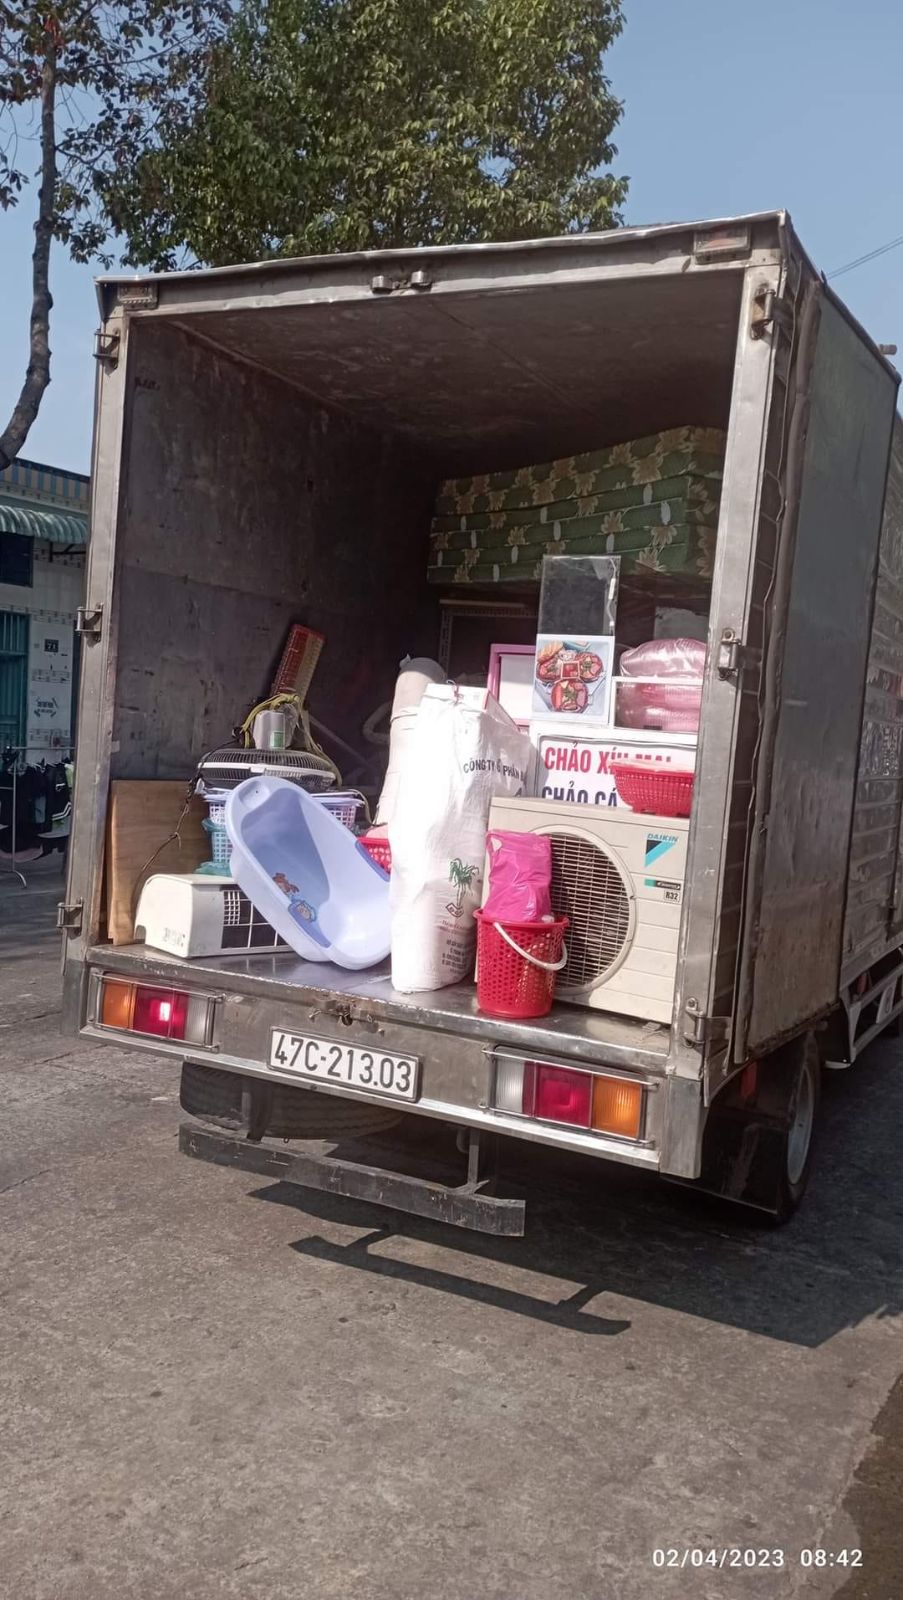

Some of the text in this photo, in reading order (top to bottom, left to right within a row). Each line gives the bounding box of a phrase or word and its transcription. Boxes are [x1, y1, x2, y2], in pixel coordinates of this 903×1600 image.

[544, 740, 592, 773] CHẢO
[647, 833, 679, 842] DAIKIN
[665, 891, 679, 900] R32
[274, 1034, 412, 1092] 47C-213.03
